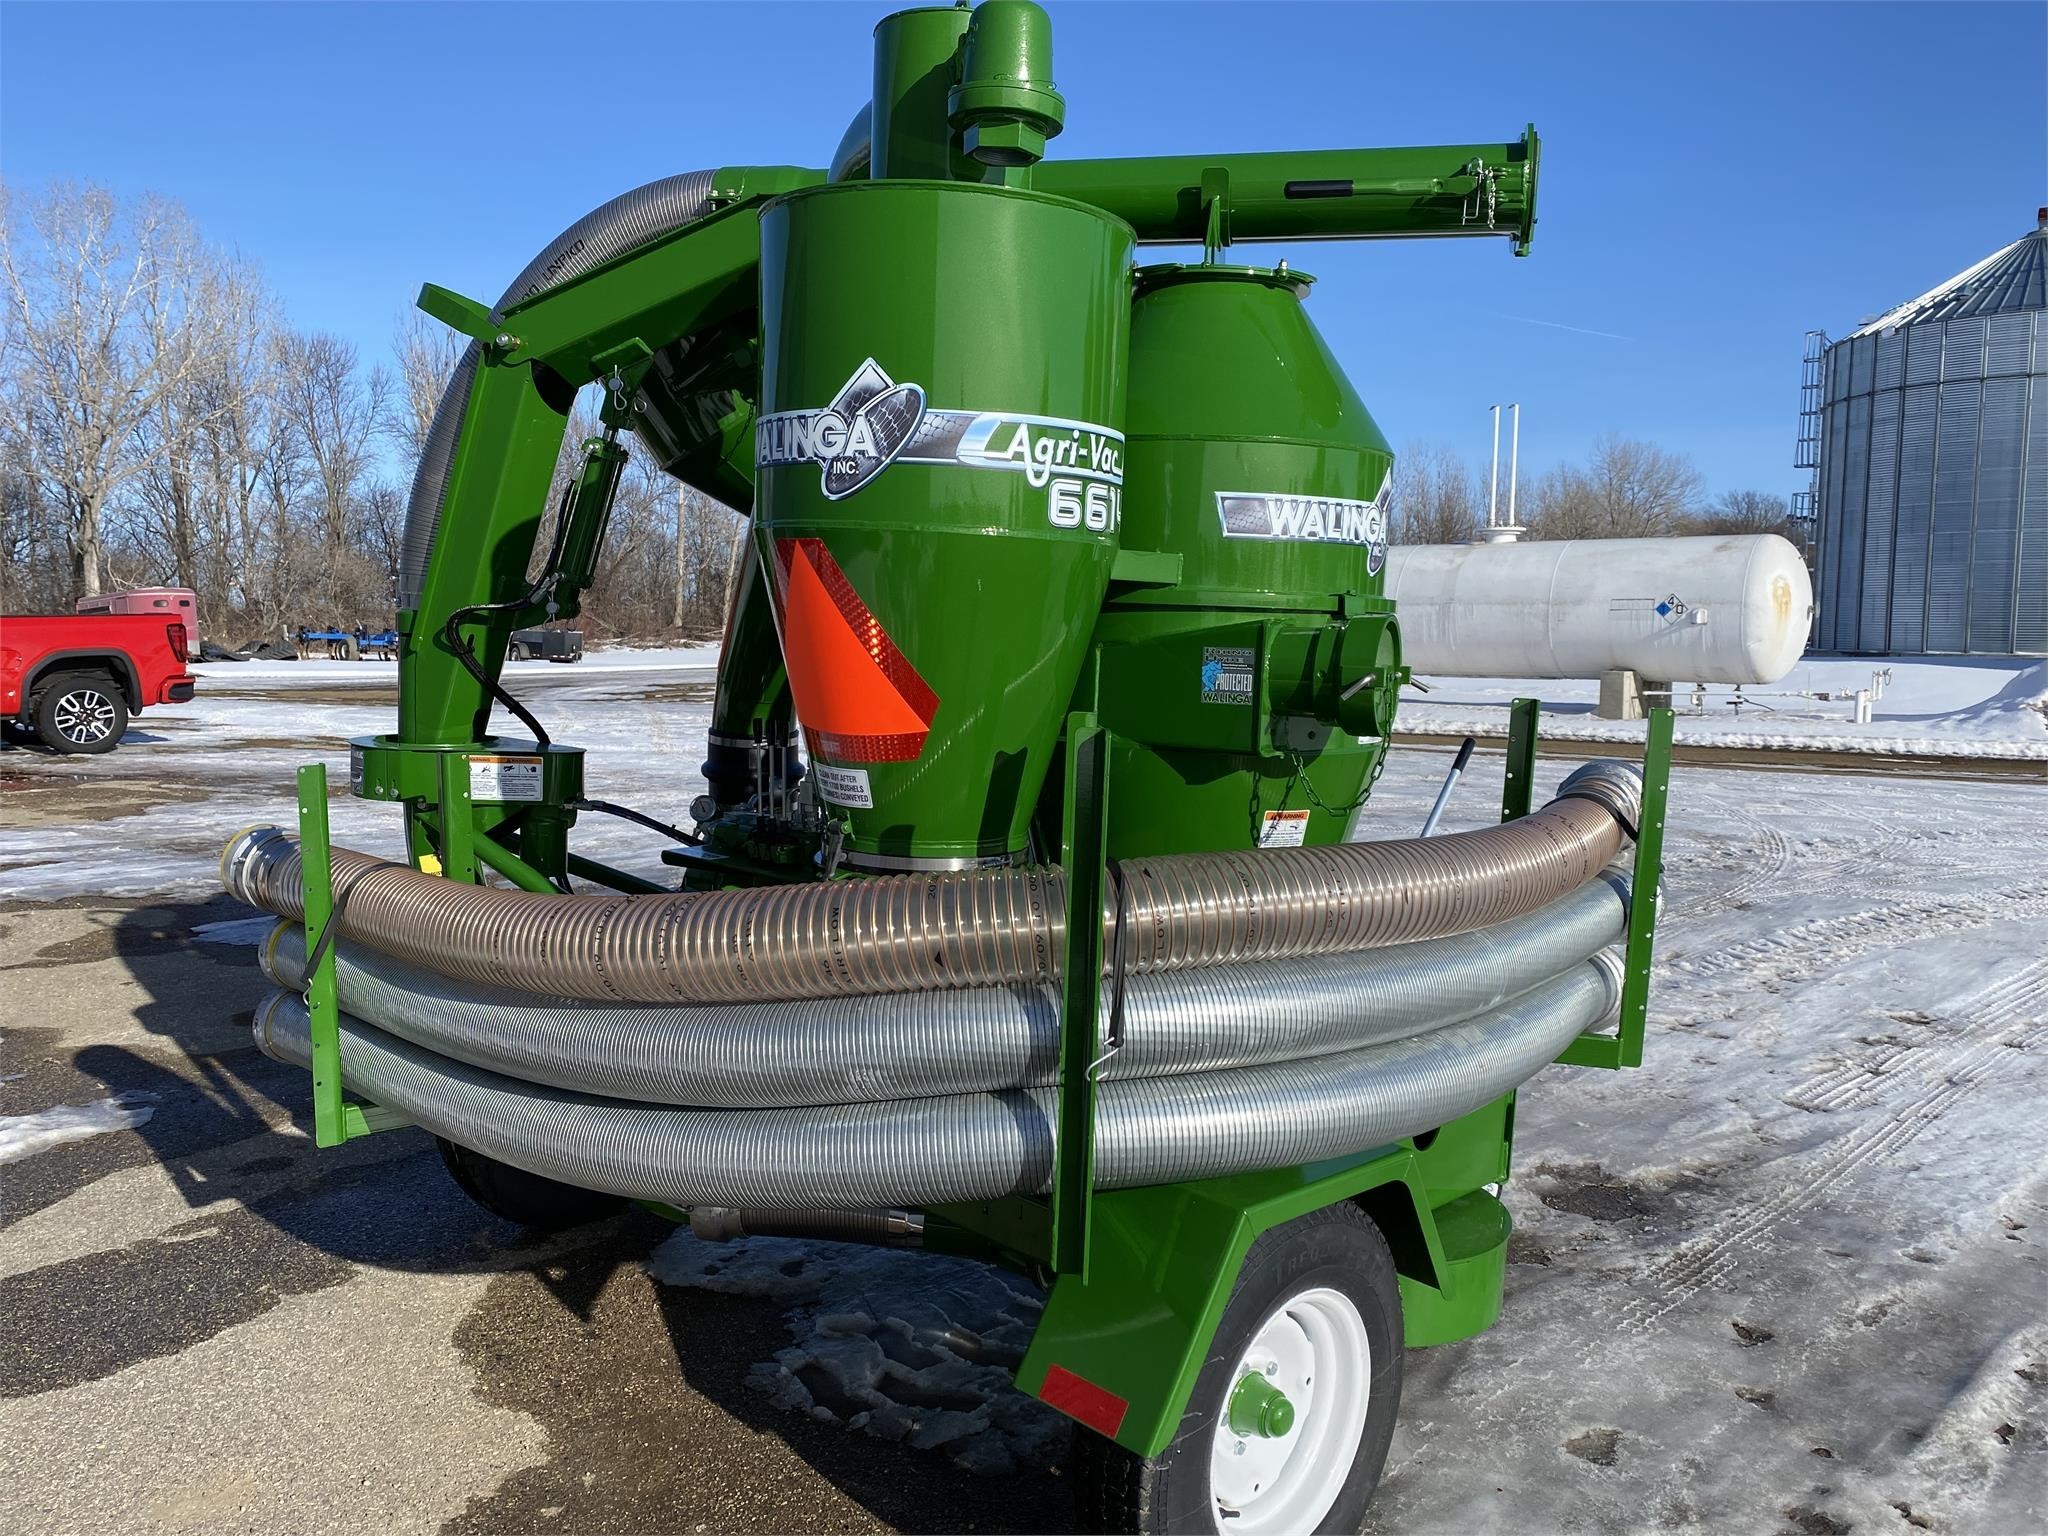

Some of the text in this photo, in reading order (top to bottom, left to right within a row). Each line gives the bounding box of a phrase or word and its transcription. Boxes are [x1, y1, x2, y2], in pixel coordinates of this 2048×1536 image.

[832, 461, 860, 475] INC.
[1267, 498, 1387, 543] WALINGA
[1668, 596, 1674, 606] 4
[1676, 604, 1684, 614] 0
[1215, 673, 1253, 692] PROTECTED
[1202, 693, 1251, 704] WALINGA
[840, 774, 857, 783] AFTER
[840, 783, 865, 793] BUSHELS
[840, 792, 869, 802] CONVEYED
